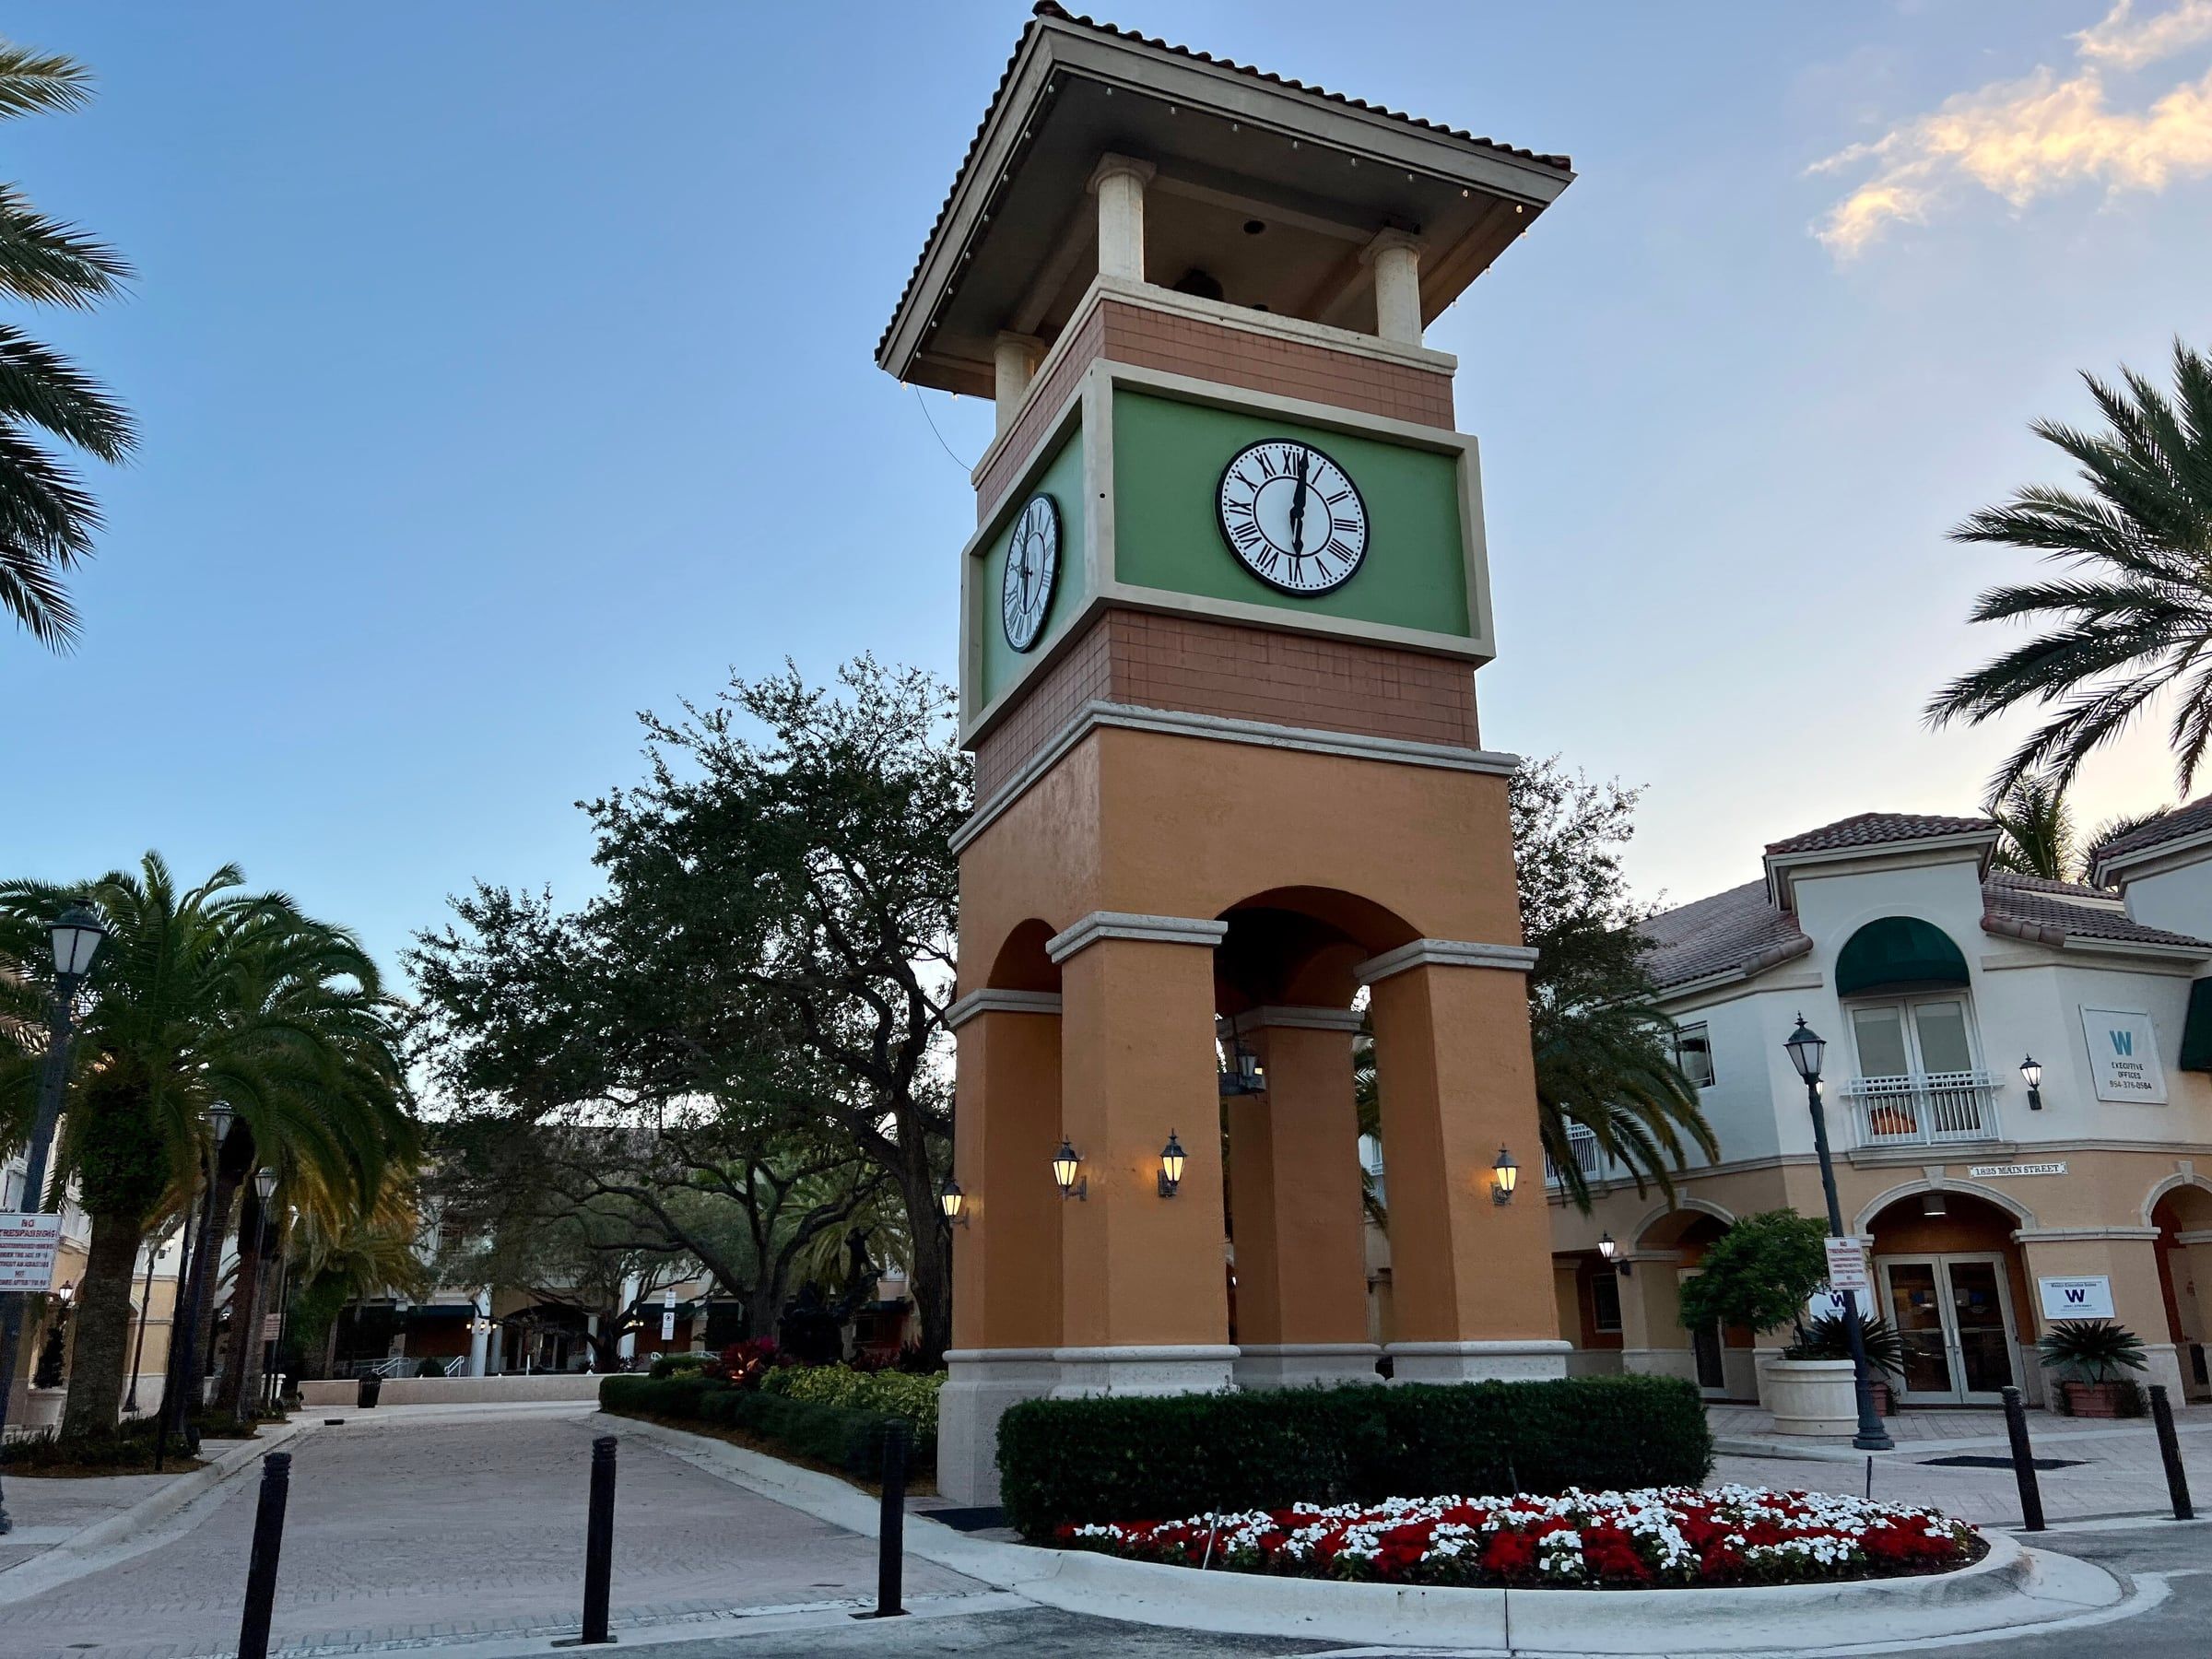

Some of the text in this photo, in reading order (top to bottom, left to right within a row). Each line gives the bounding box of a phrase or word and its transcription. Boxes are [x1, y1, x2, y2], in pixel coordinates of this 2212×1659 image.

[1254, 452, 1277, 479] XI
[1234, 470, 1259, 493] X
[1228, 498, 1253, 517] IX
[1325, 490, 1349, 506] II
[1232, 521, 1263, 551] VIII
[1334, 518, 1359, 533] III
[1256, 543, 1279, 573] VII
[1314, 556, 1333, 581] V
[1288, 557, 1304, 583] VI
[2110, 1030, 2132, 1056] W
[2112, 1062, 2144, 1071] EXECUTIVE
[2118, 1071, 2141, 1079] OFFICES
[1998, 1166, 2022, 1174] MAIN
[2024, 1165, 2059, 1173] STREET
[2065, 1289, 2085, 1303] W
